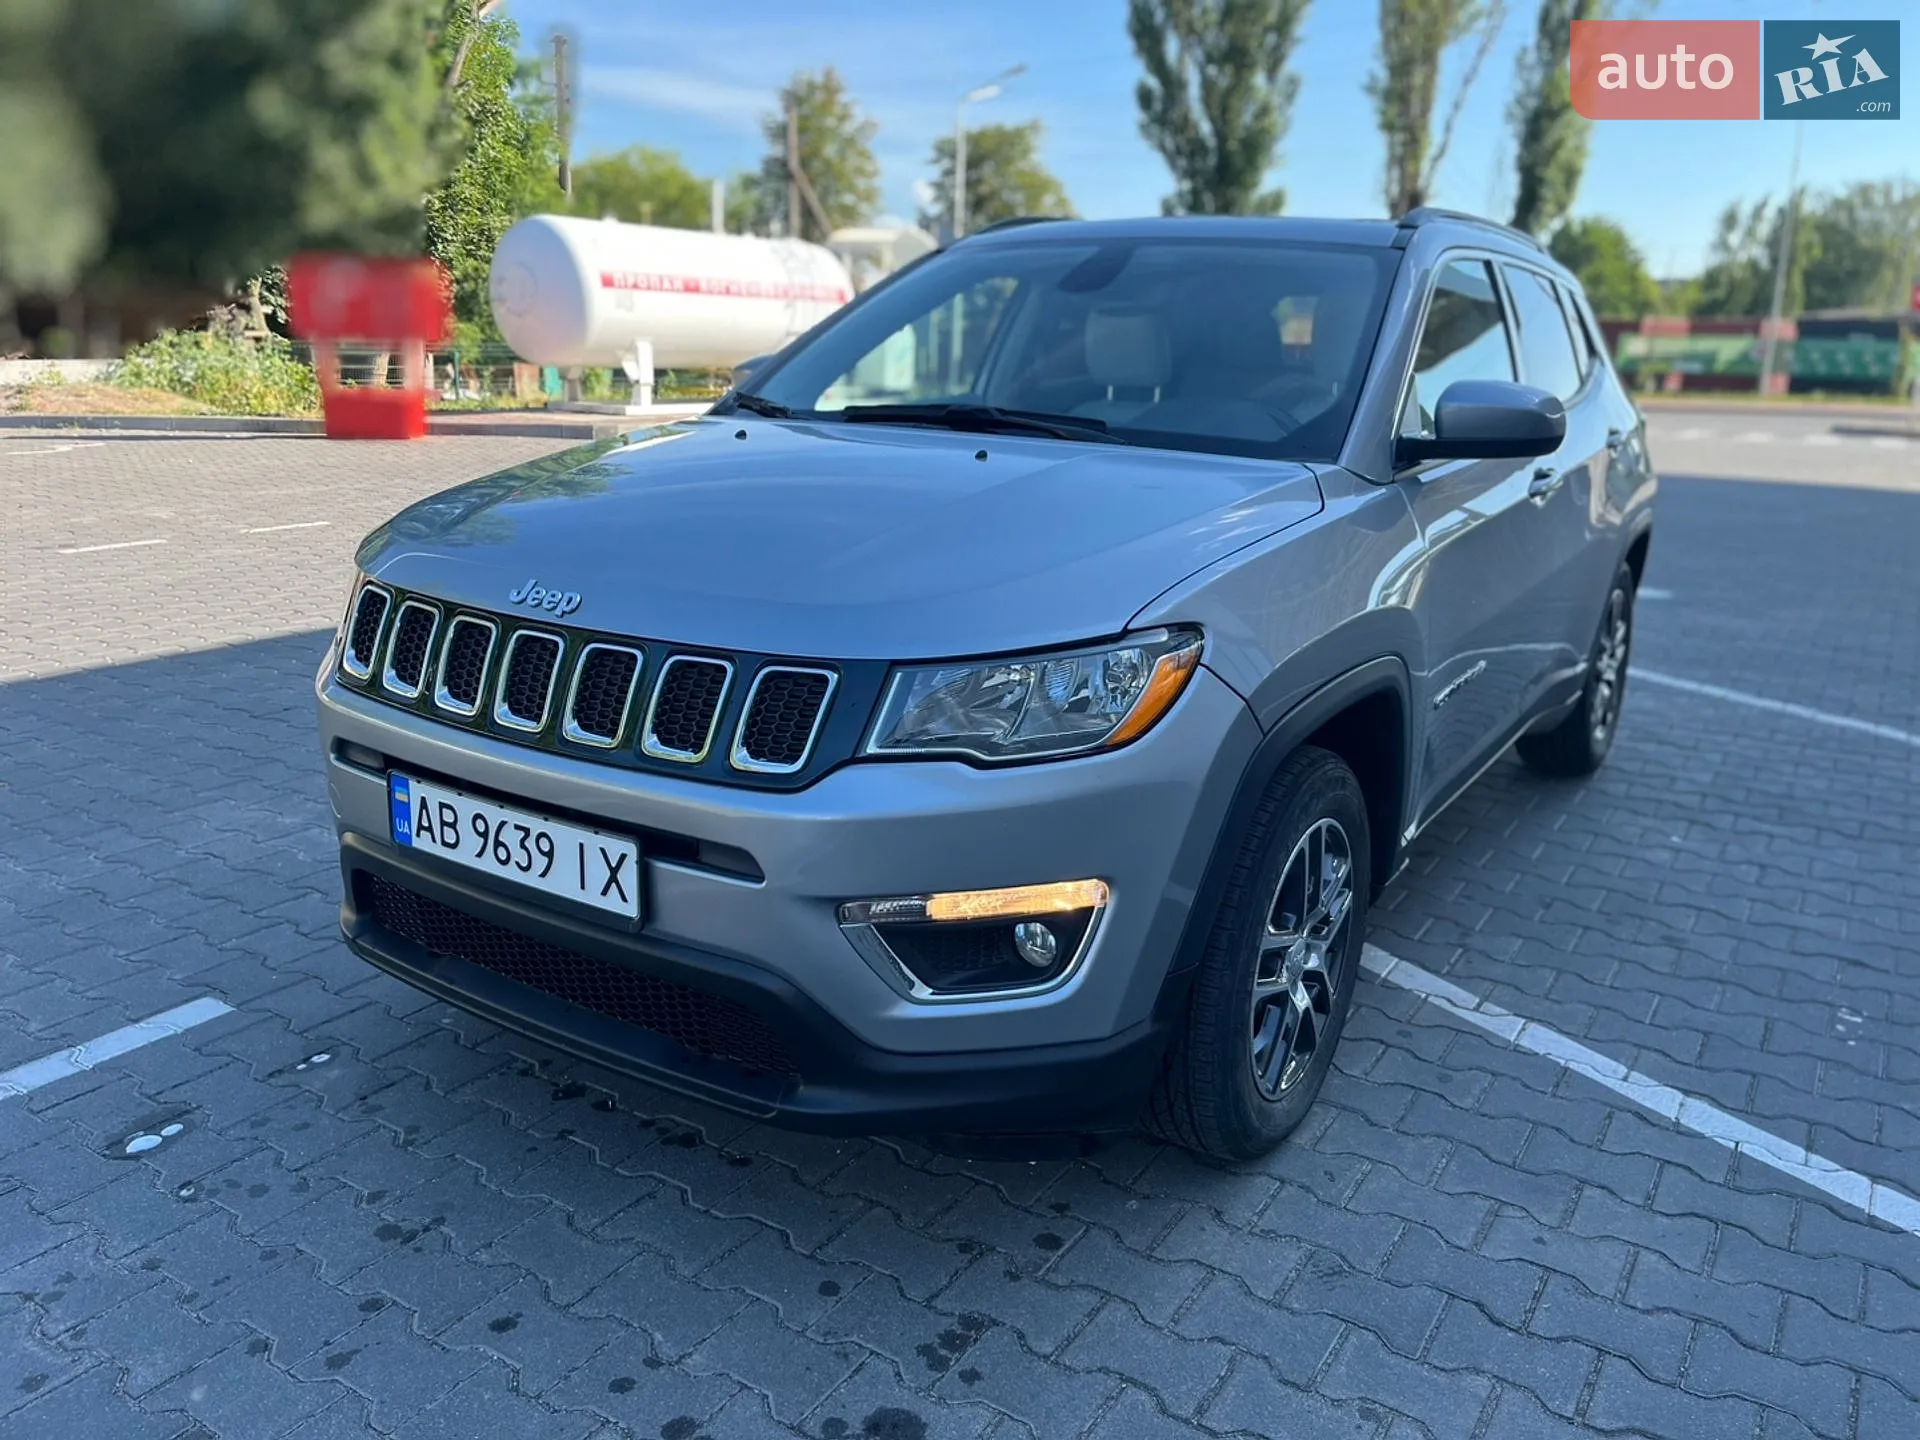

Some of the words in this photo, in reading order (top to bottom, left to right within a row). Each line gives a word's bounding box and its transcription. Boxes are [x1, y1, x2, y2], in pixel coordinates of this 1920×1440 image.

[509, 578, 583, 619] Jeep
[396, 819, 411, 836] UA
[415, 795, 461, 850] AB
[471, 813, 555, 878] 9639
[578, 841, 629, 903] IX
